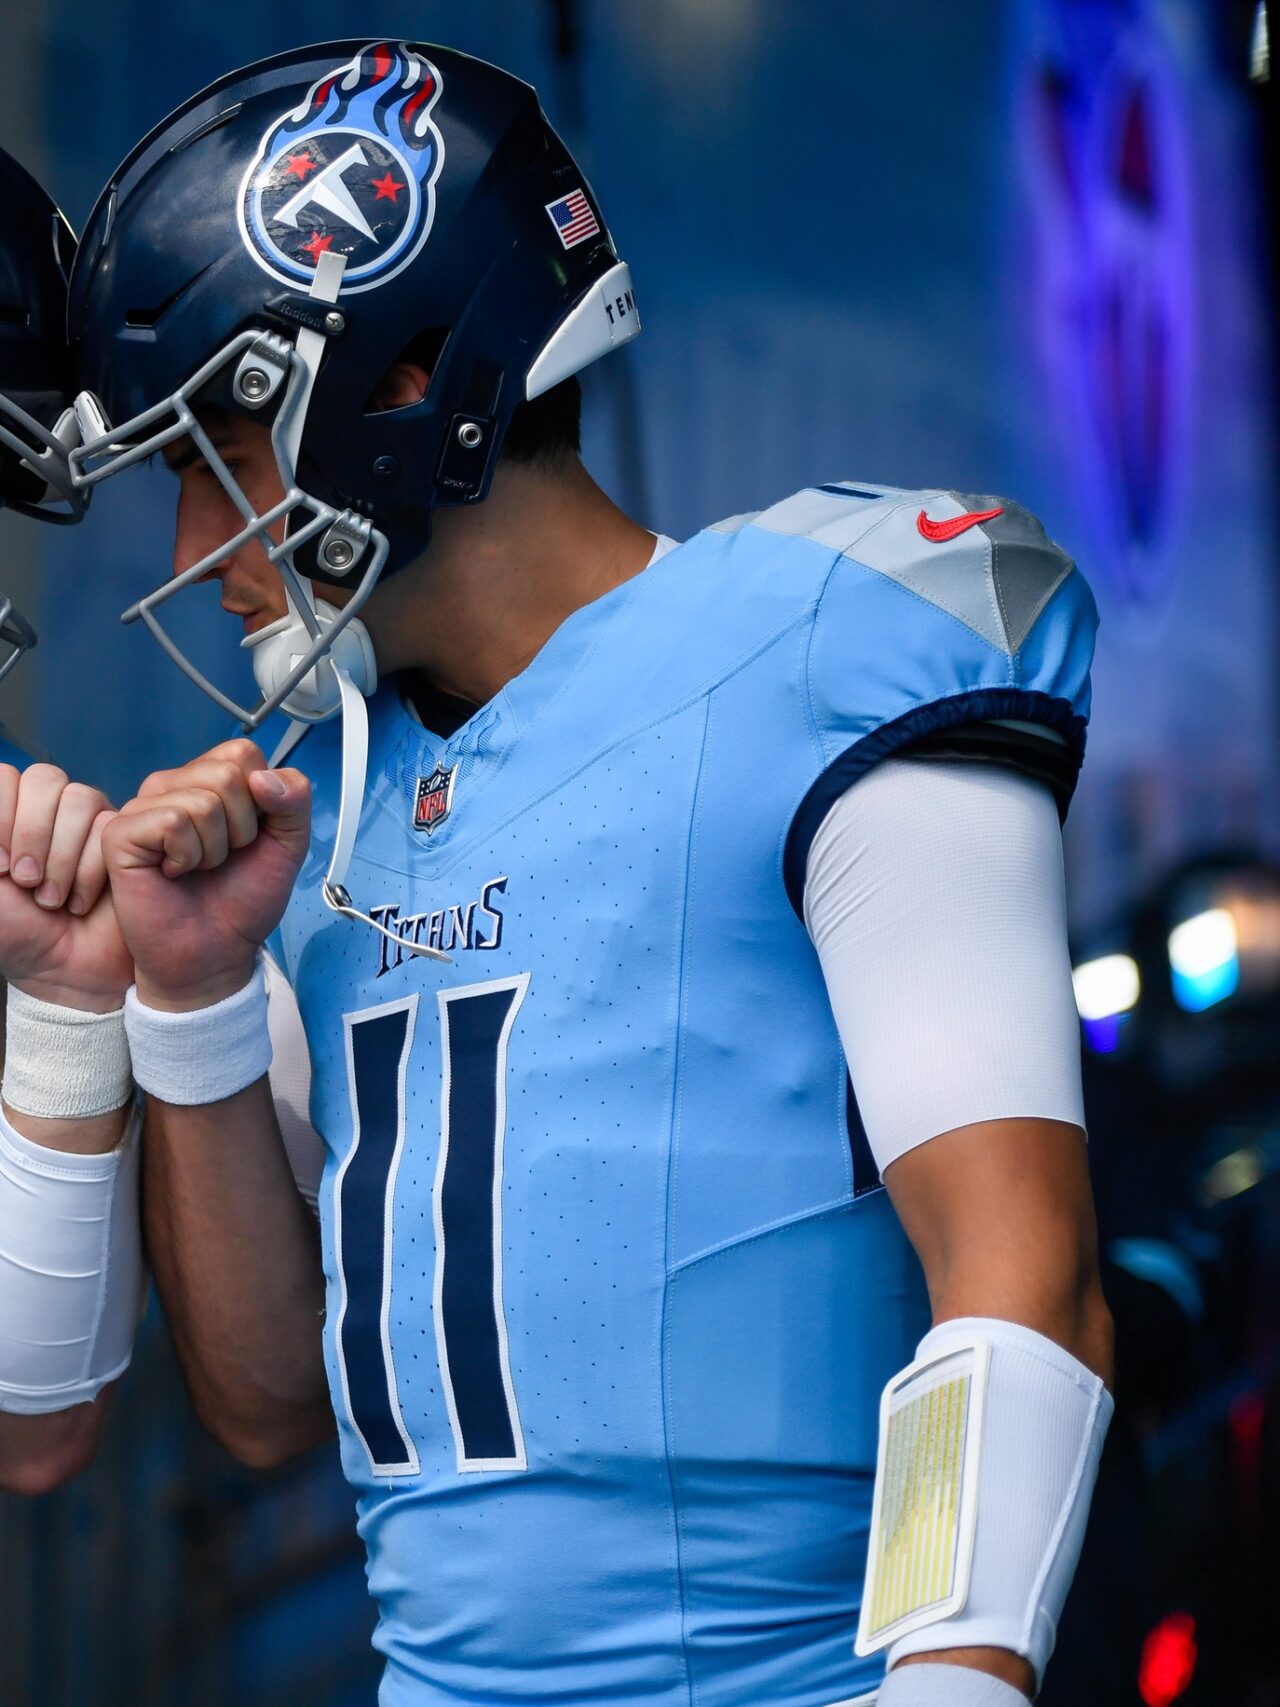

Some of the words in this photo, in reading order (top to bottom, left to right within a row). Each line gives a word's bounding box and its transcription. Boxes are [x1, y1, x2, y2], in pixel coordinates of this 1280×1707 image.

[418, 790, 446, 821] NFL
[370, 876, 509, 979] TITANS
[333, 971, 532, 1477] 11
